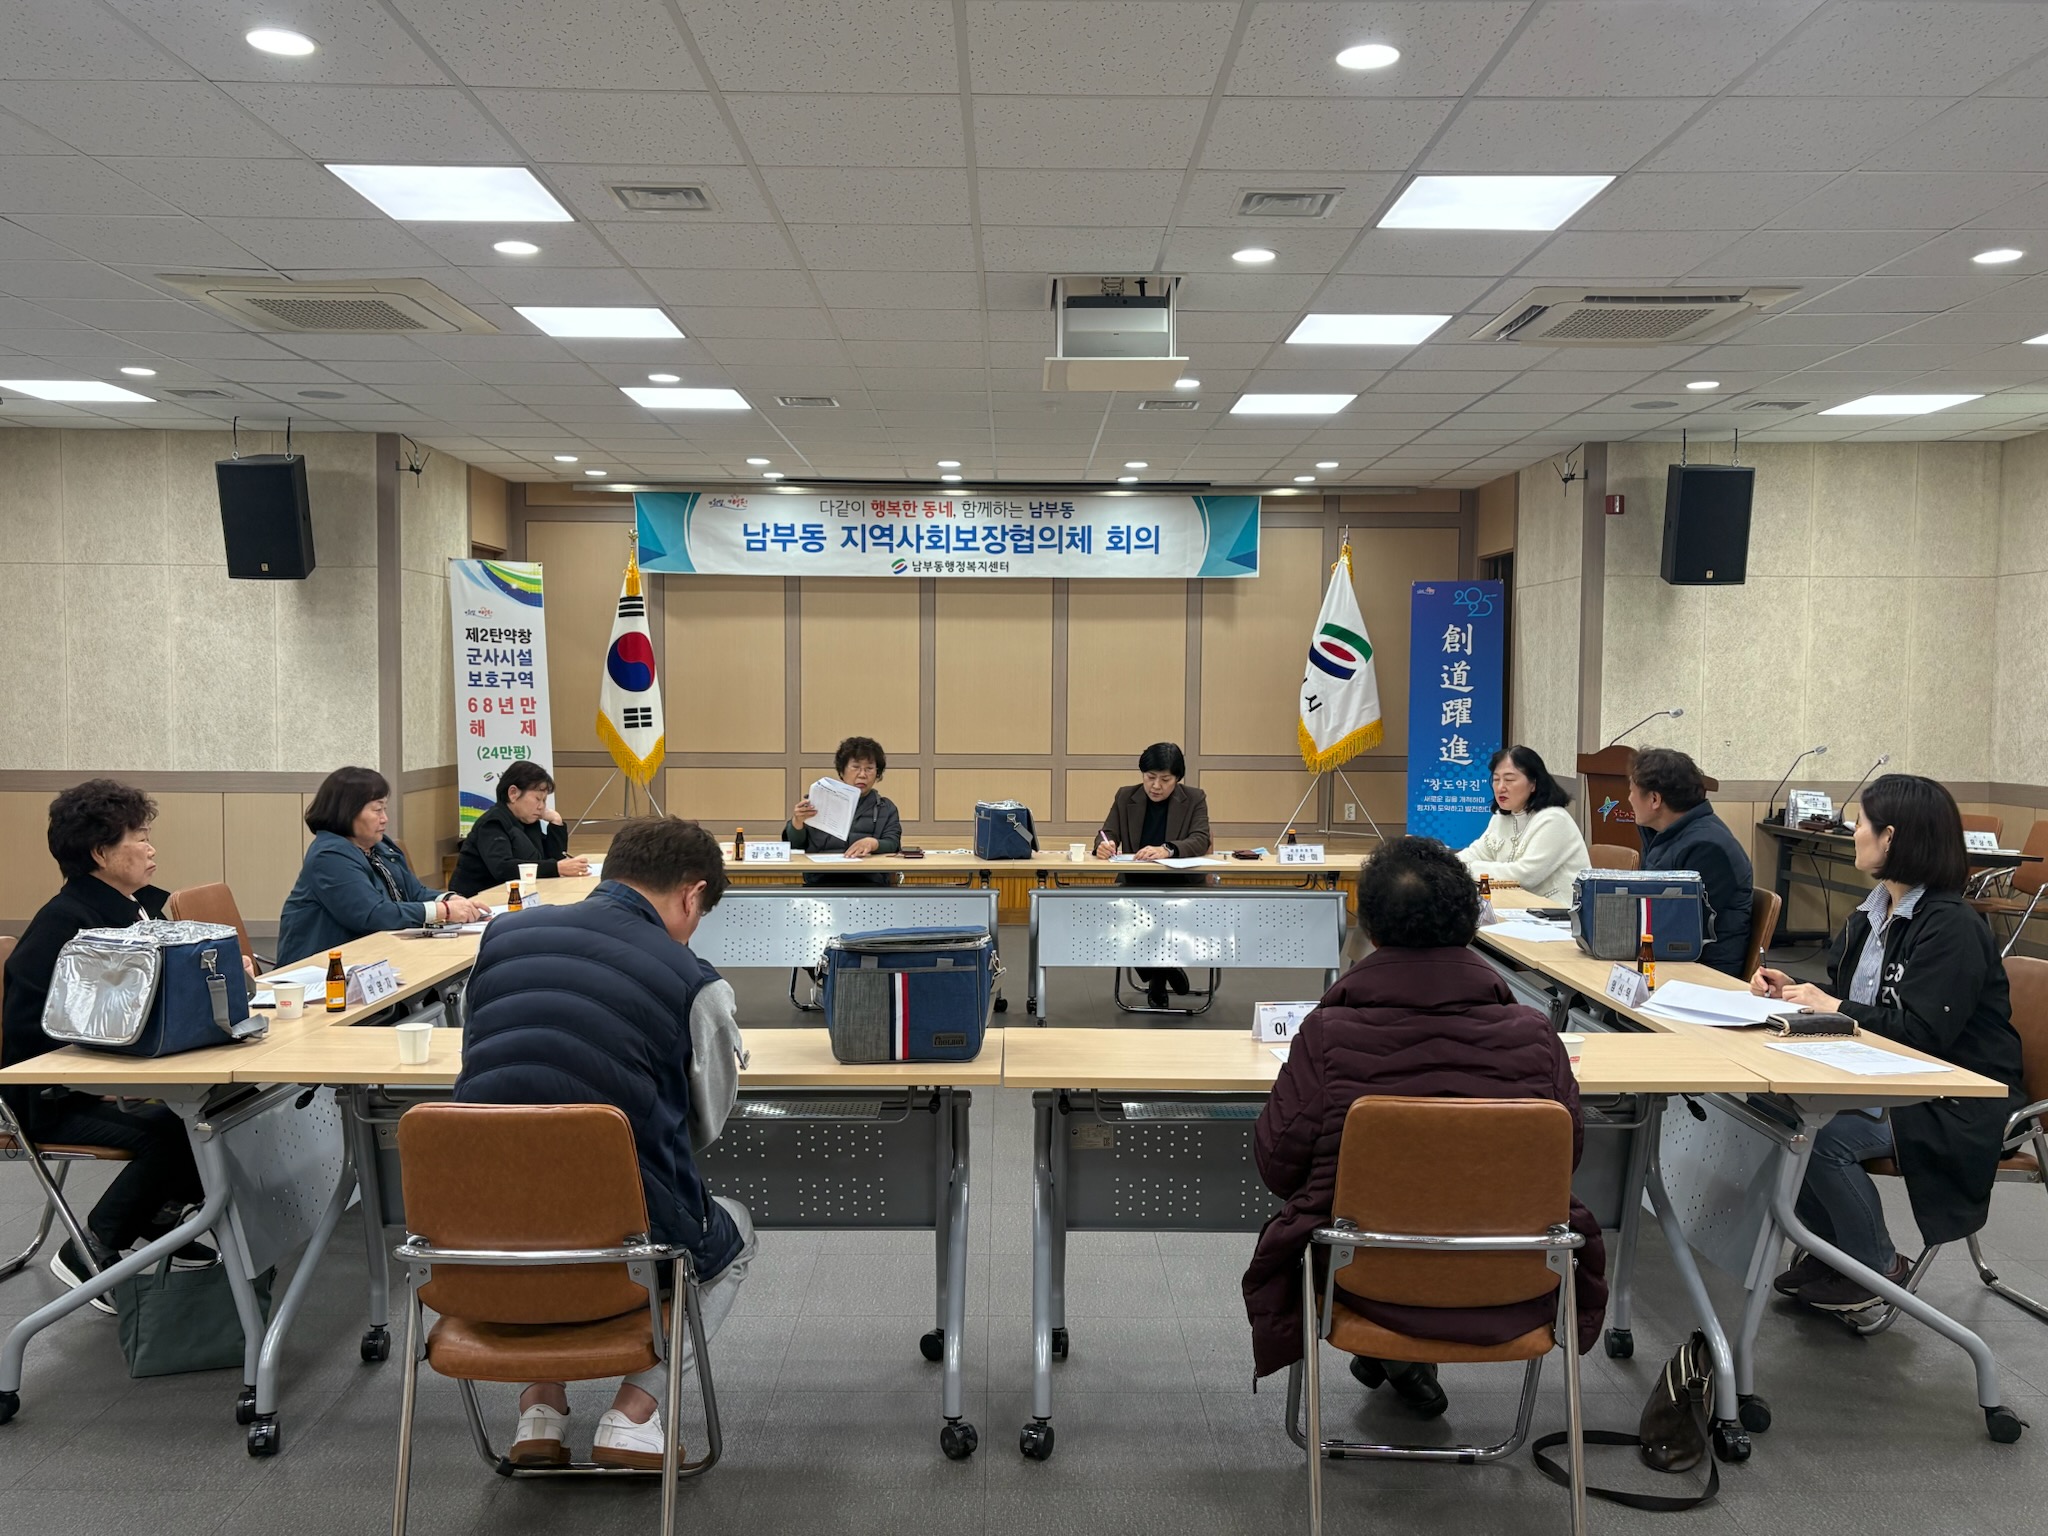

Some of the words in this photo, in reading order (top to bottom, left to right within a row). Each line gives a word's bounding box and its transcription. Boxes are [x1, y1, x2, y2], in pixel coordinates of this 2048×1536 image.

[819, 500, 866, 518] 다같이
[870, 500, 918, 519] 행복한
[921, 500, 957, 519] 동네,
[961, 500, 1024, 519] 함께하는
[1028, 501, 1076, 519] 남부동
[742, 522, 828, 553] 남부동
[840, 523, 1093, 555] 지역사회보장협의체
[1105, 524, 1161, 555] 회의
[911, 560, 1010, 573] 남부동행정복지센터
[465, 626, 532, 645] 제2탄약창
[466, 647, 533, 667] 군사시설
[467, 670, 535, 690] 보호구역
[1439, 622, 1475, 766] 創道躍進
[476, 744, 532, 761] (24만평)
